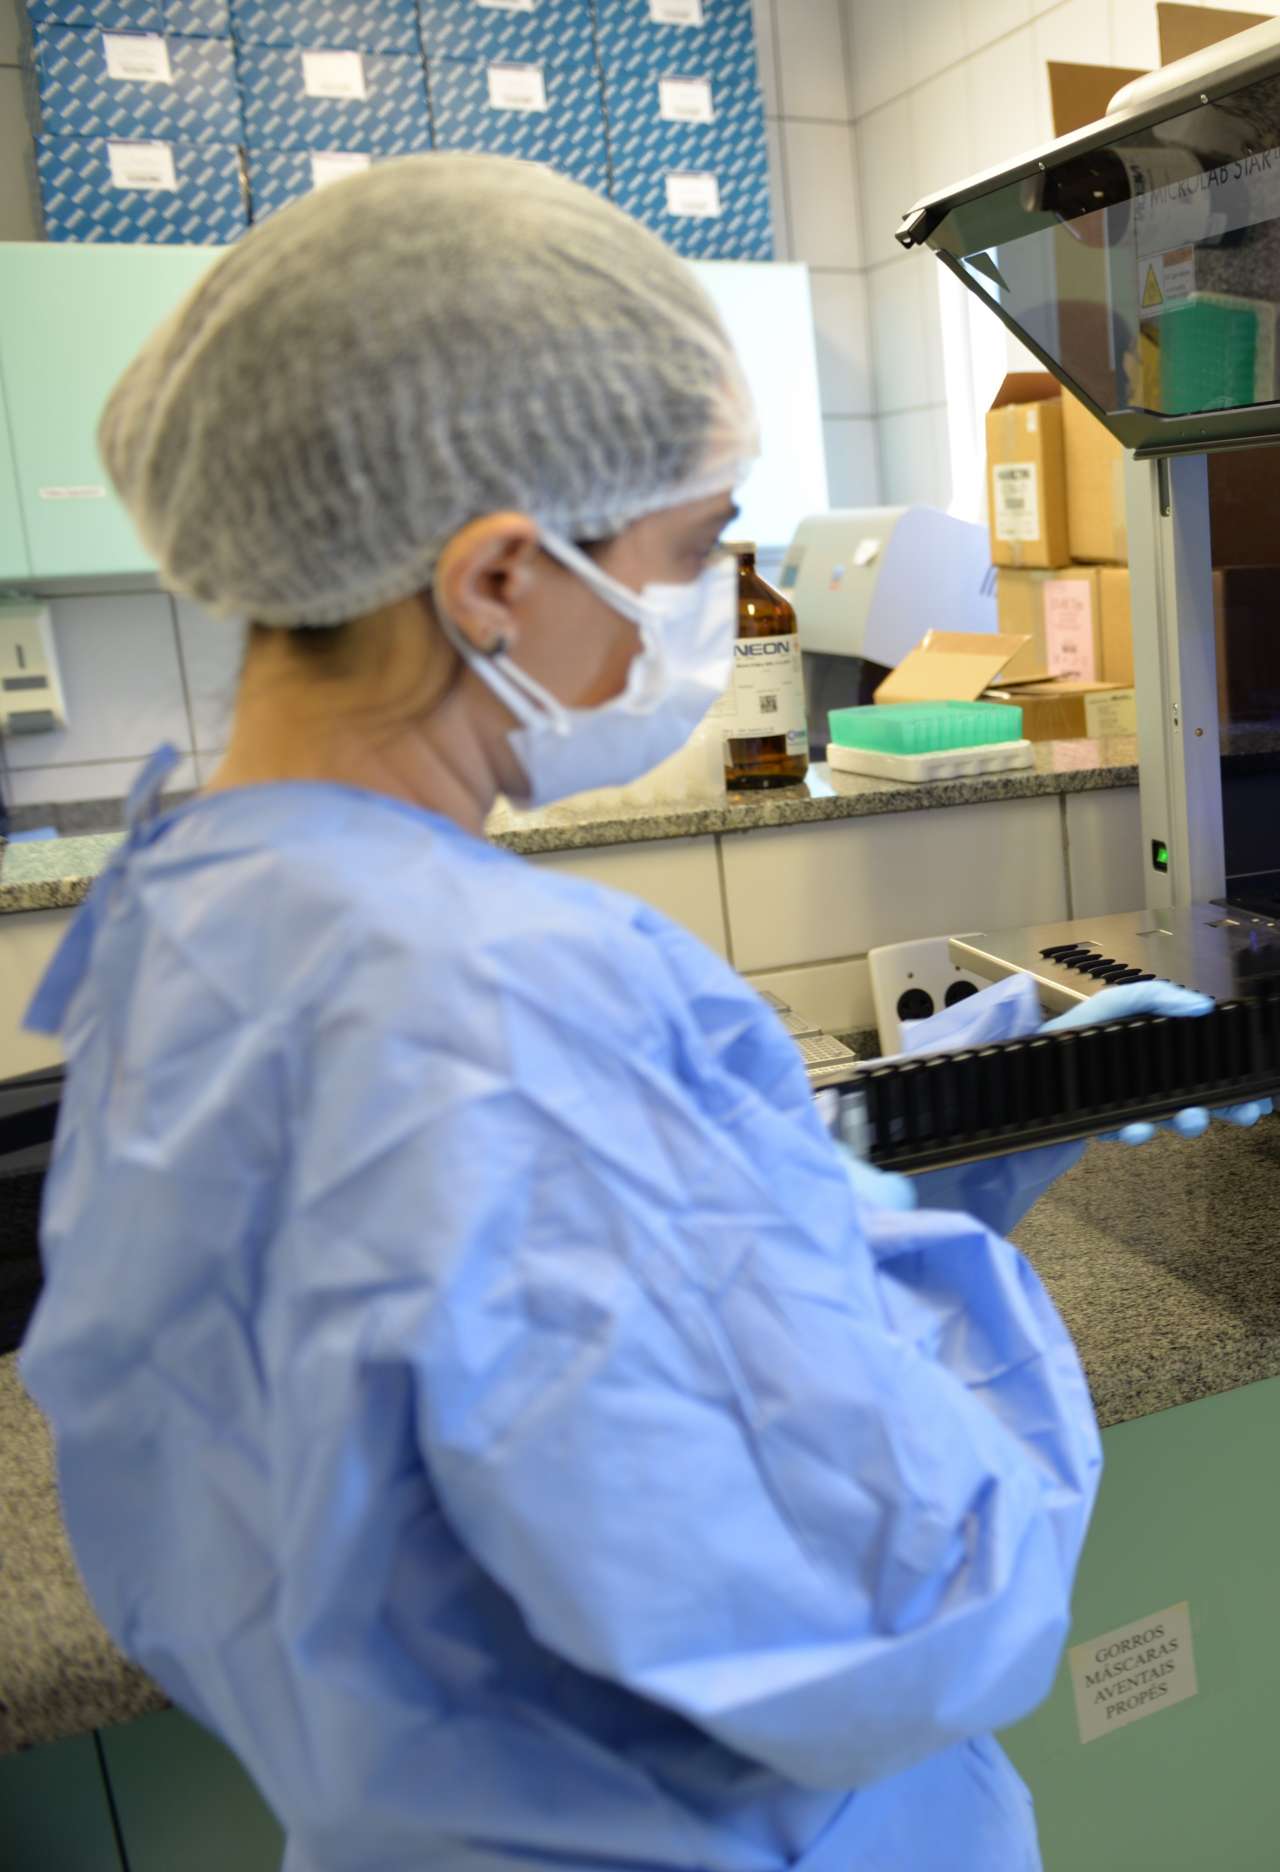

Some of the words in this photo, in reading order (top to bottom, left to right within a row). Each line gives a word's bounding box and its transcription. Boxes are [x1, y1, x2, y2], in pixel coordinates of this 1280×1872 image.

[734, 640, 790, 656] NEON
[1085, 1638, 1179, 1688] MÁSCARAS
[1095, 1624, 1165, 1663] GORROS
[1094, 1659, 1176, 1704] AVENTAIS
